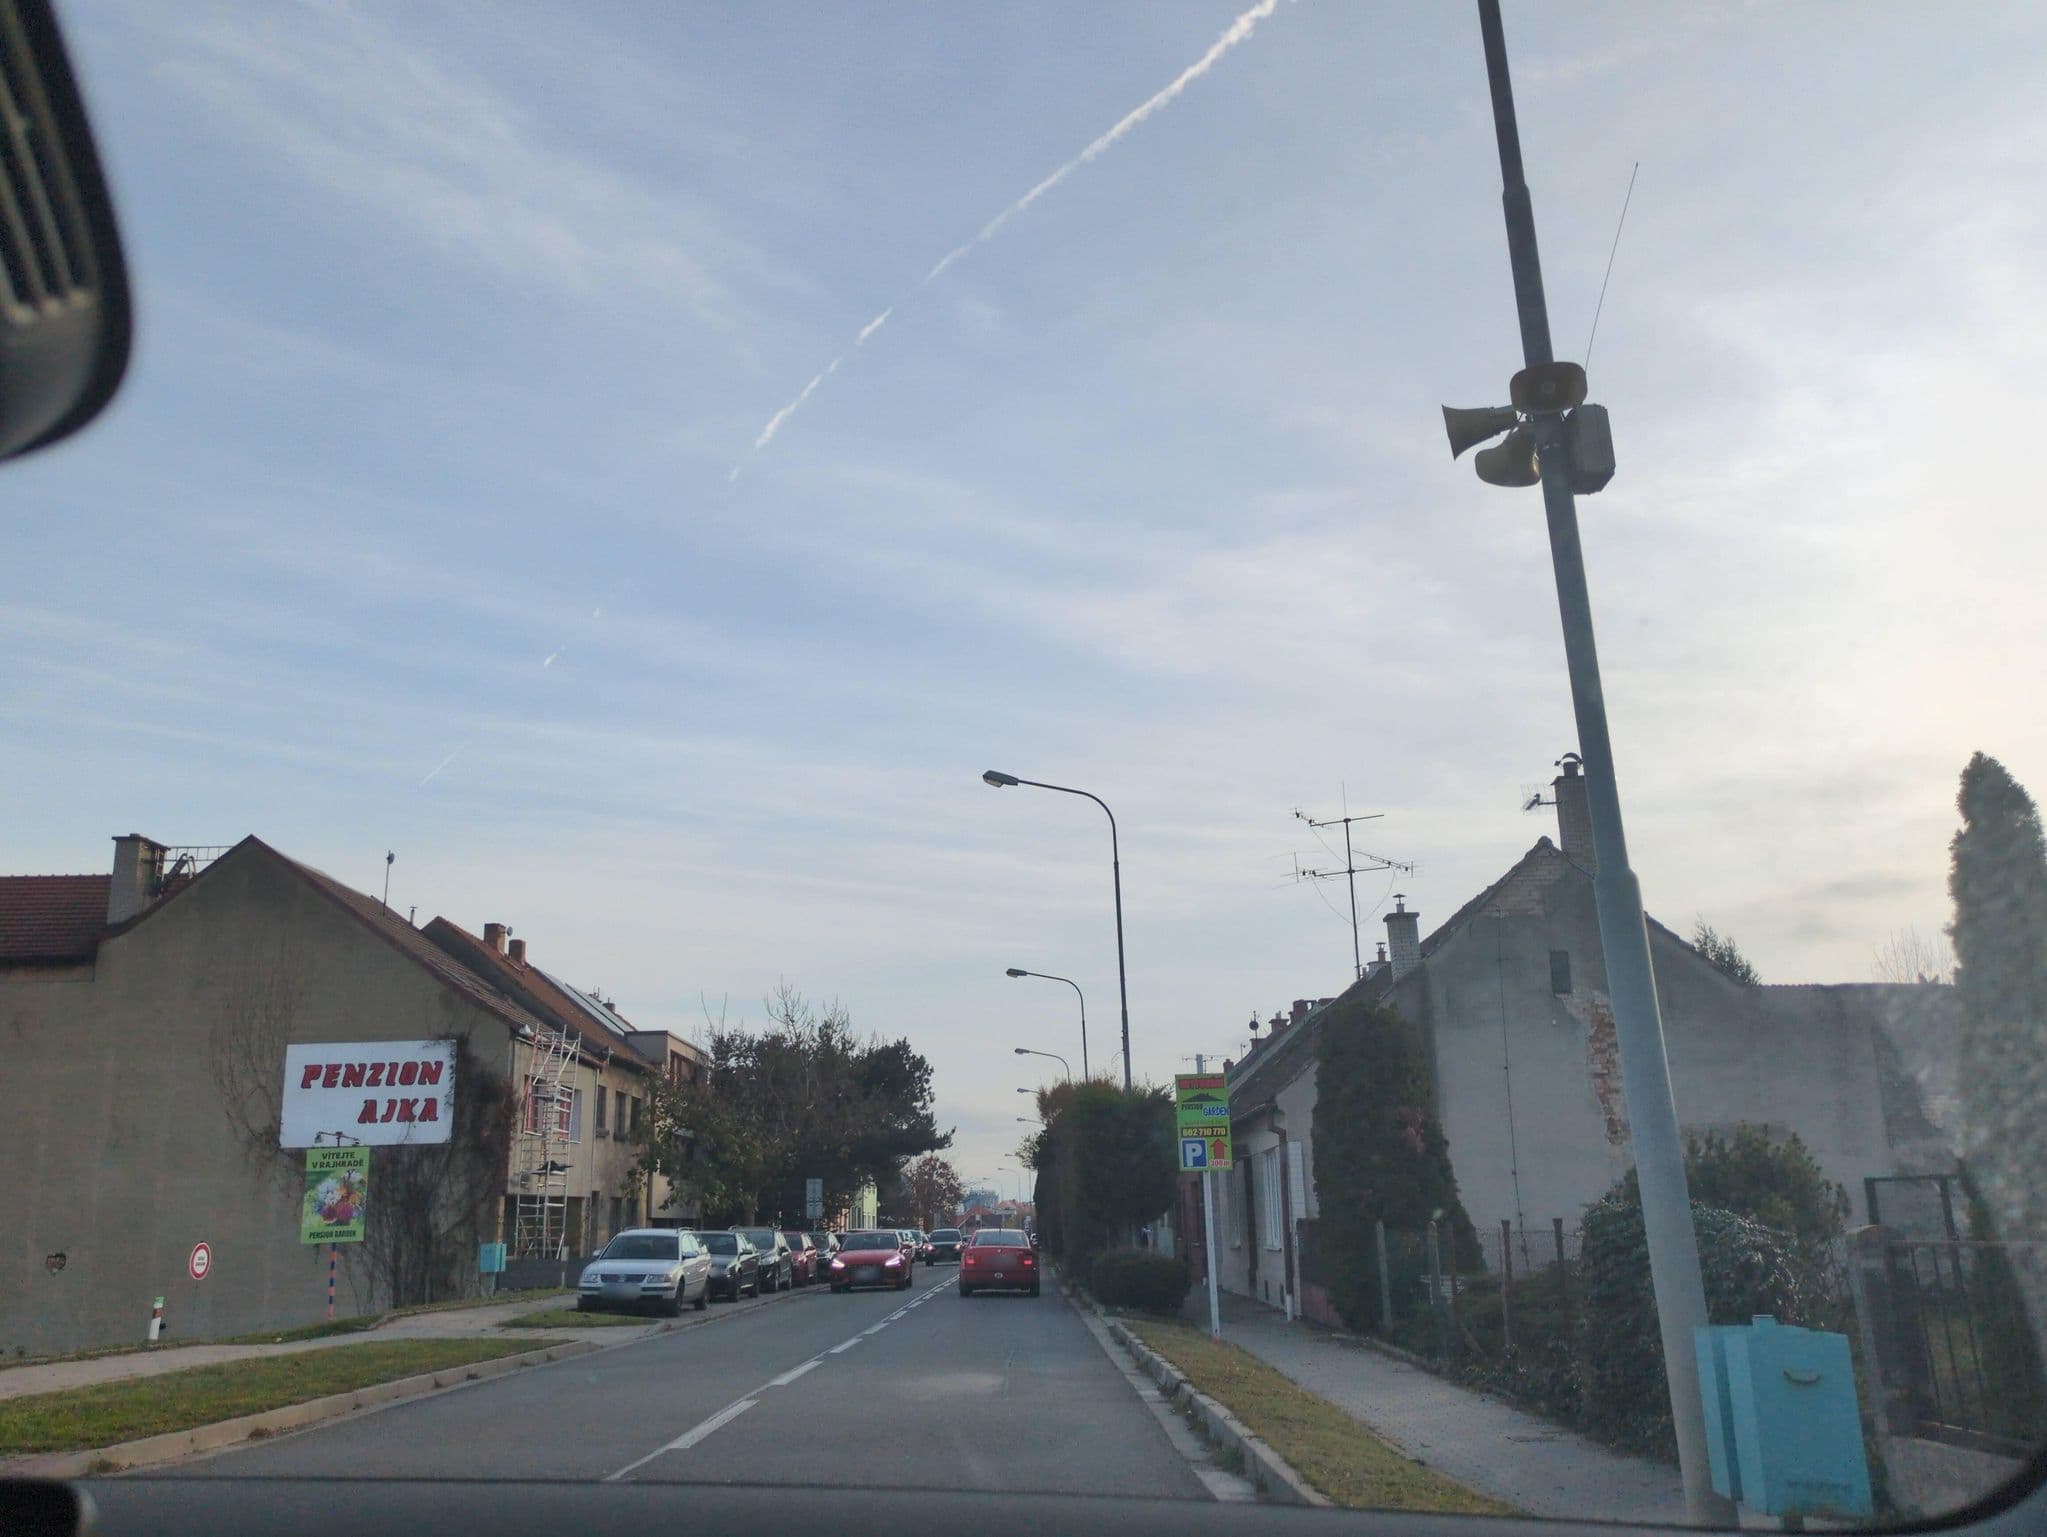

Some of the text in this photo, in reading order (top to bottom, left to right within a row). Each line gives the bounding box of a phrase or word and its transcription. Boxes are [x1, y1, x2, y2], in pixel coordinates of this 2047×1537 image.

[301, 1060, 443, 1089] PENZION
[357, 1098, 438, 1124] AJKA
[1200, 1128, 1212, 1136] 710
[322, 1151, 356, 1160] VÍTEJTE
[1185, 1143, 1203, 1168] P
[312, 1161, 318, 1169] V
